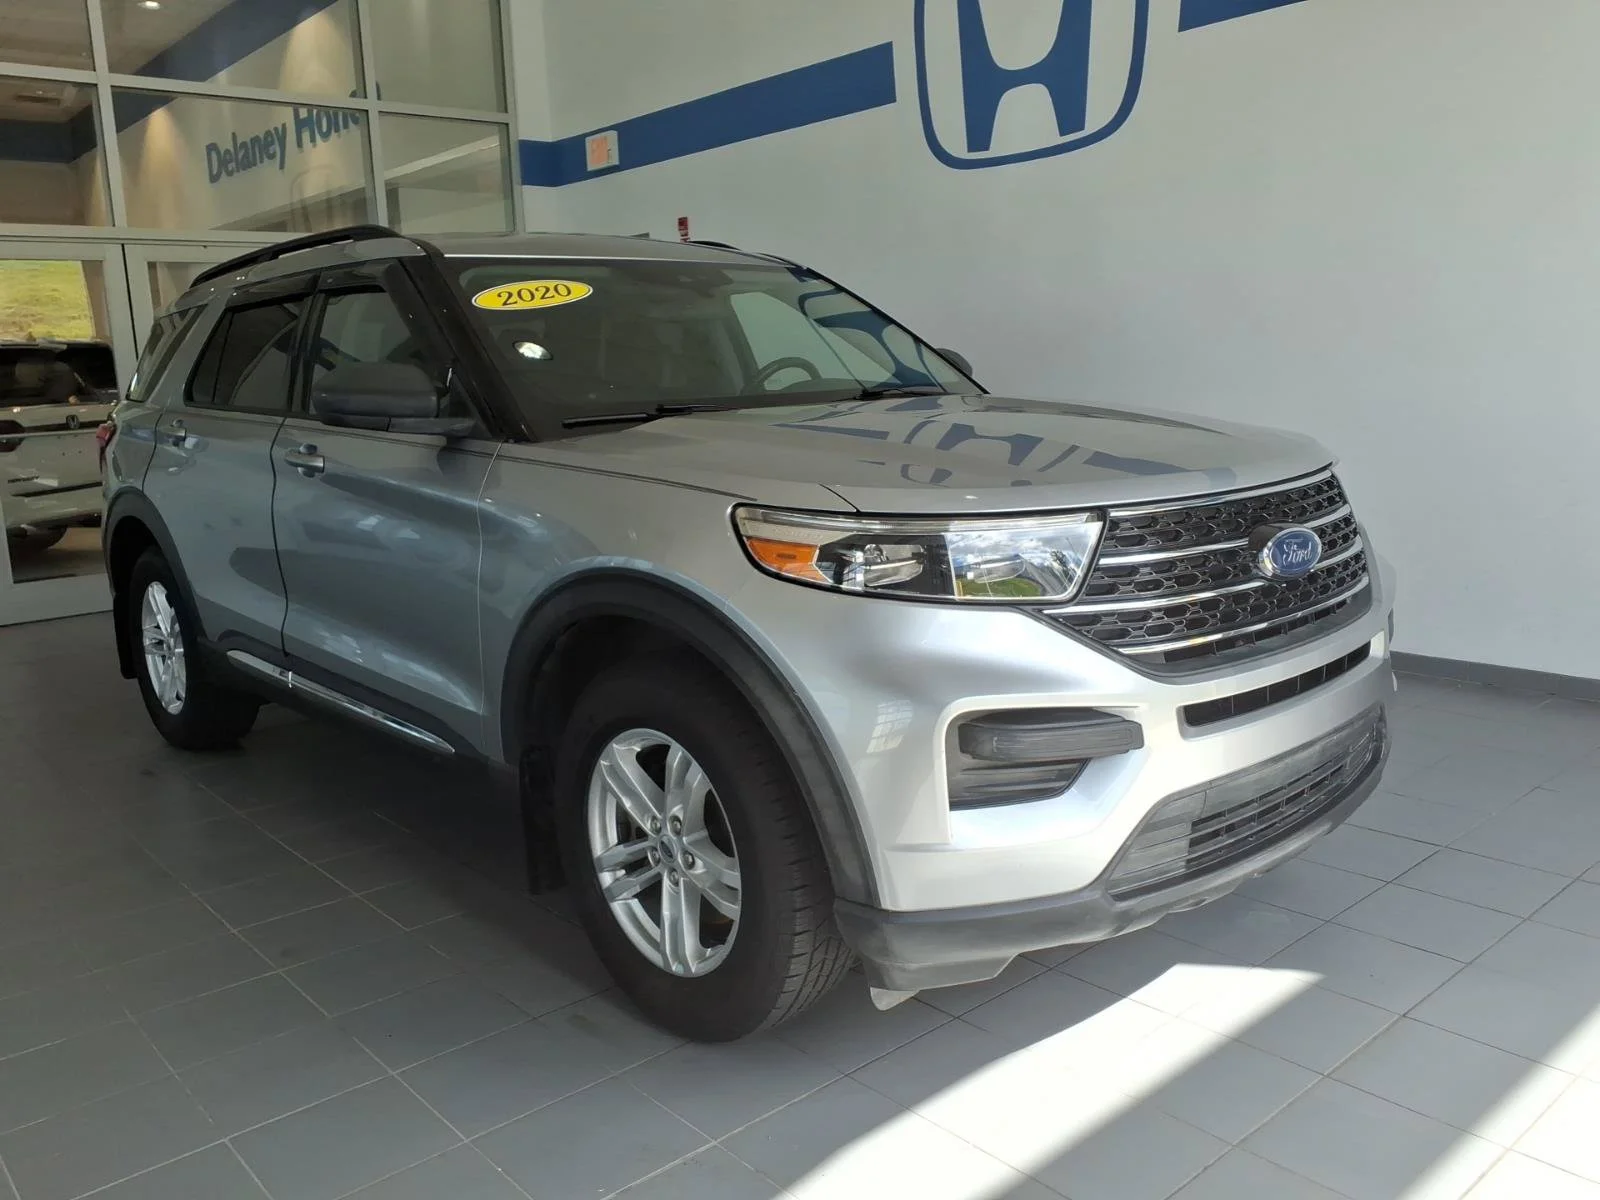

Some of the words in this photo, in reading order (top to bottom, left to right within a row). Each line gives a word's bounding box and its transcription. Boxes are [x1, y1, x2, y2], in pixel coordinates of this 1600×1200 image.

[205, 123, 288, 184] Delaney
[497, 283, 572, 307] 2020
[1282, 539, 1313, 567] Ford
